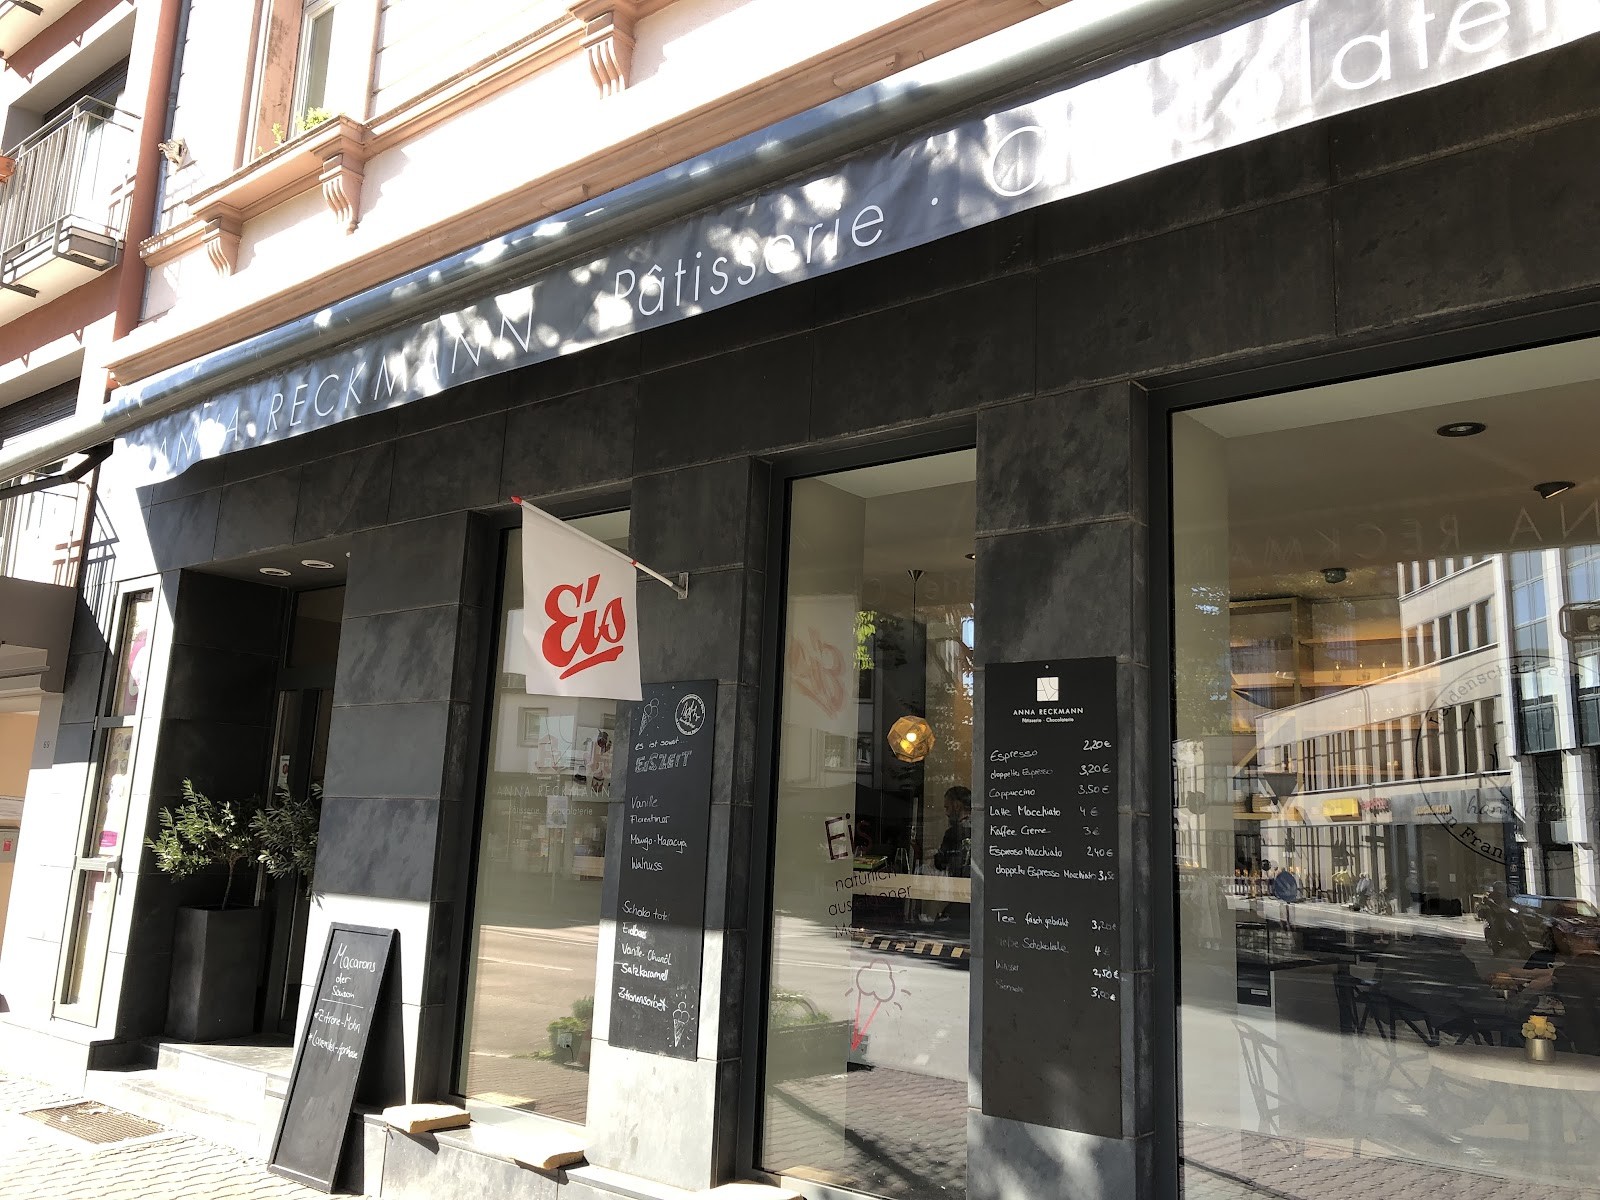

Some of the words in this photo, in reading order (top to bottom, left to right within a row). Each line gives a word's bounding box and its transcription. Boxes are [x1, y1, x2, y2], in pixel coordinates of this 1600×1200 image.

[612, 203, 885, 317] Pâtisserie
[542, 574, 626, 668] Eis
[990, 750, 1038, 763] Espresso
[989, 788, 1036, 800] Cappuccino
[1017, 805, 1061, 817] Macchiato
[990, 825, 1017, 837] Kaffee
[622, 900, 651, 919] Schoko
[991, 908, 1016, 924] Tee
[333, 942, 376, 973] Macarons
[335, 972, 352, 985] der
